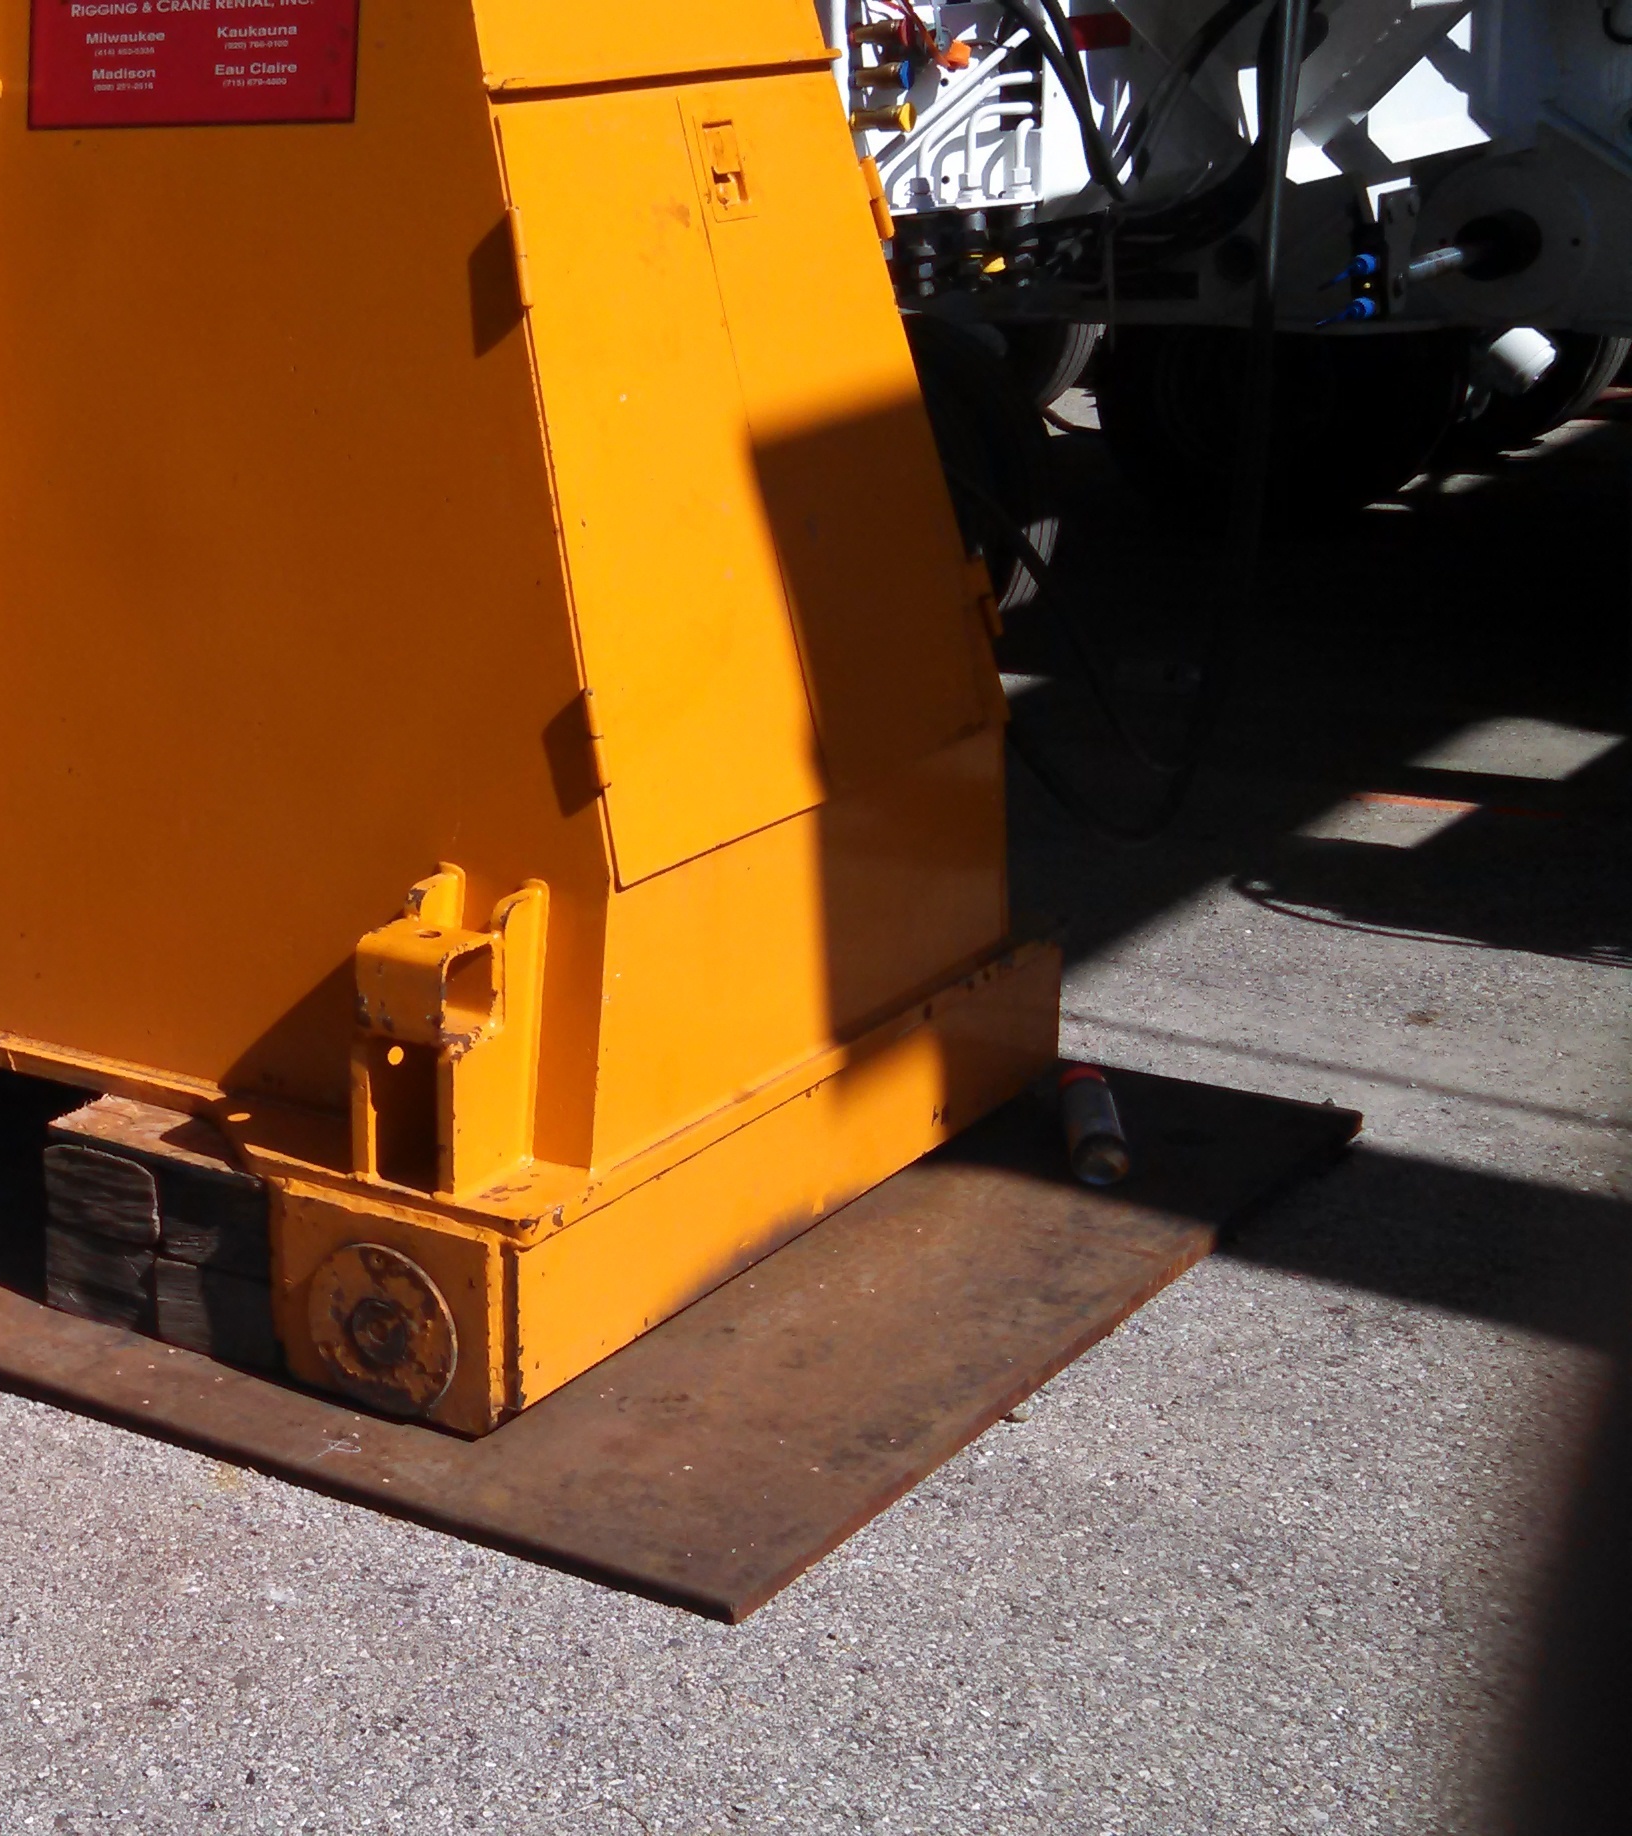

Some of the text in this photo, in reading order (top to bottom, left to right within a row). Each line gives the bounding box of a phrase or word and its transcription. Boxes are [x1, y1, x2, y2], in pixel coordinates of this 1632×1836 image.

[71, 3, 138, 17] RIGGING
[142, 2, 152, 14] &
[156, 0, 211, 13] CRANE
[85, 31, 166, 44] Milwaukee
[217, 25, 298, 39] Kaukauna
[92, 67, 156, 80] Madison
[214, 61, 298, 76] Eau Claire
